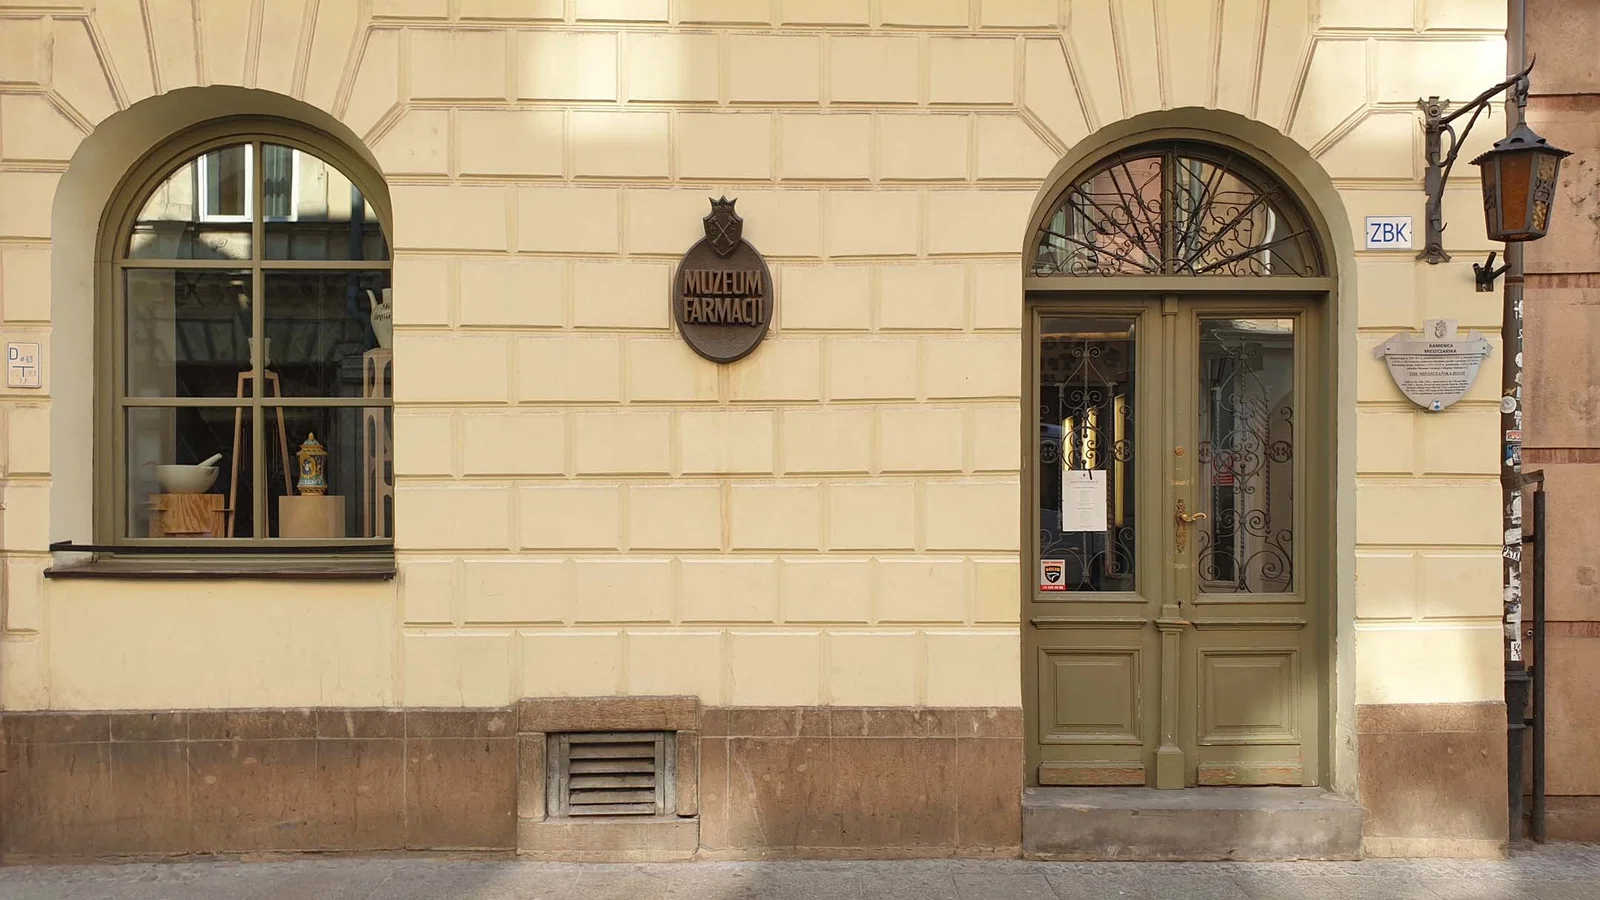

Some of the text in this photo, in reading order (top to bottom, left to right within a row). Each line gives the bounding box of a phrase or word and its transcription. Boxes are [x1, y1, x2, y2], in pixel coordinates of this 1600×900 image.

[1370, 222, 1408, 243] ZBK
[683, 269, 763, 296] MUZEUM
[682, 297, 764, 326] FARMACJI
[10, 347, 18, 360] D
